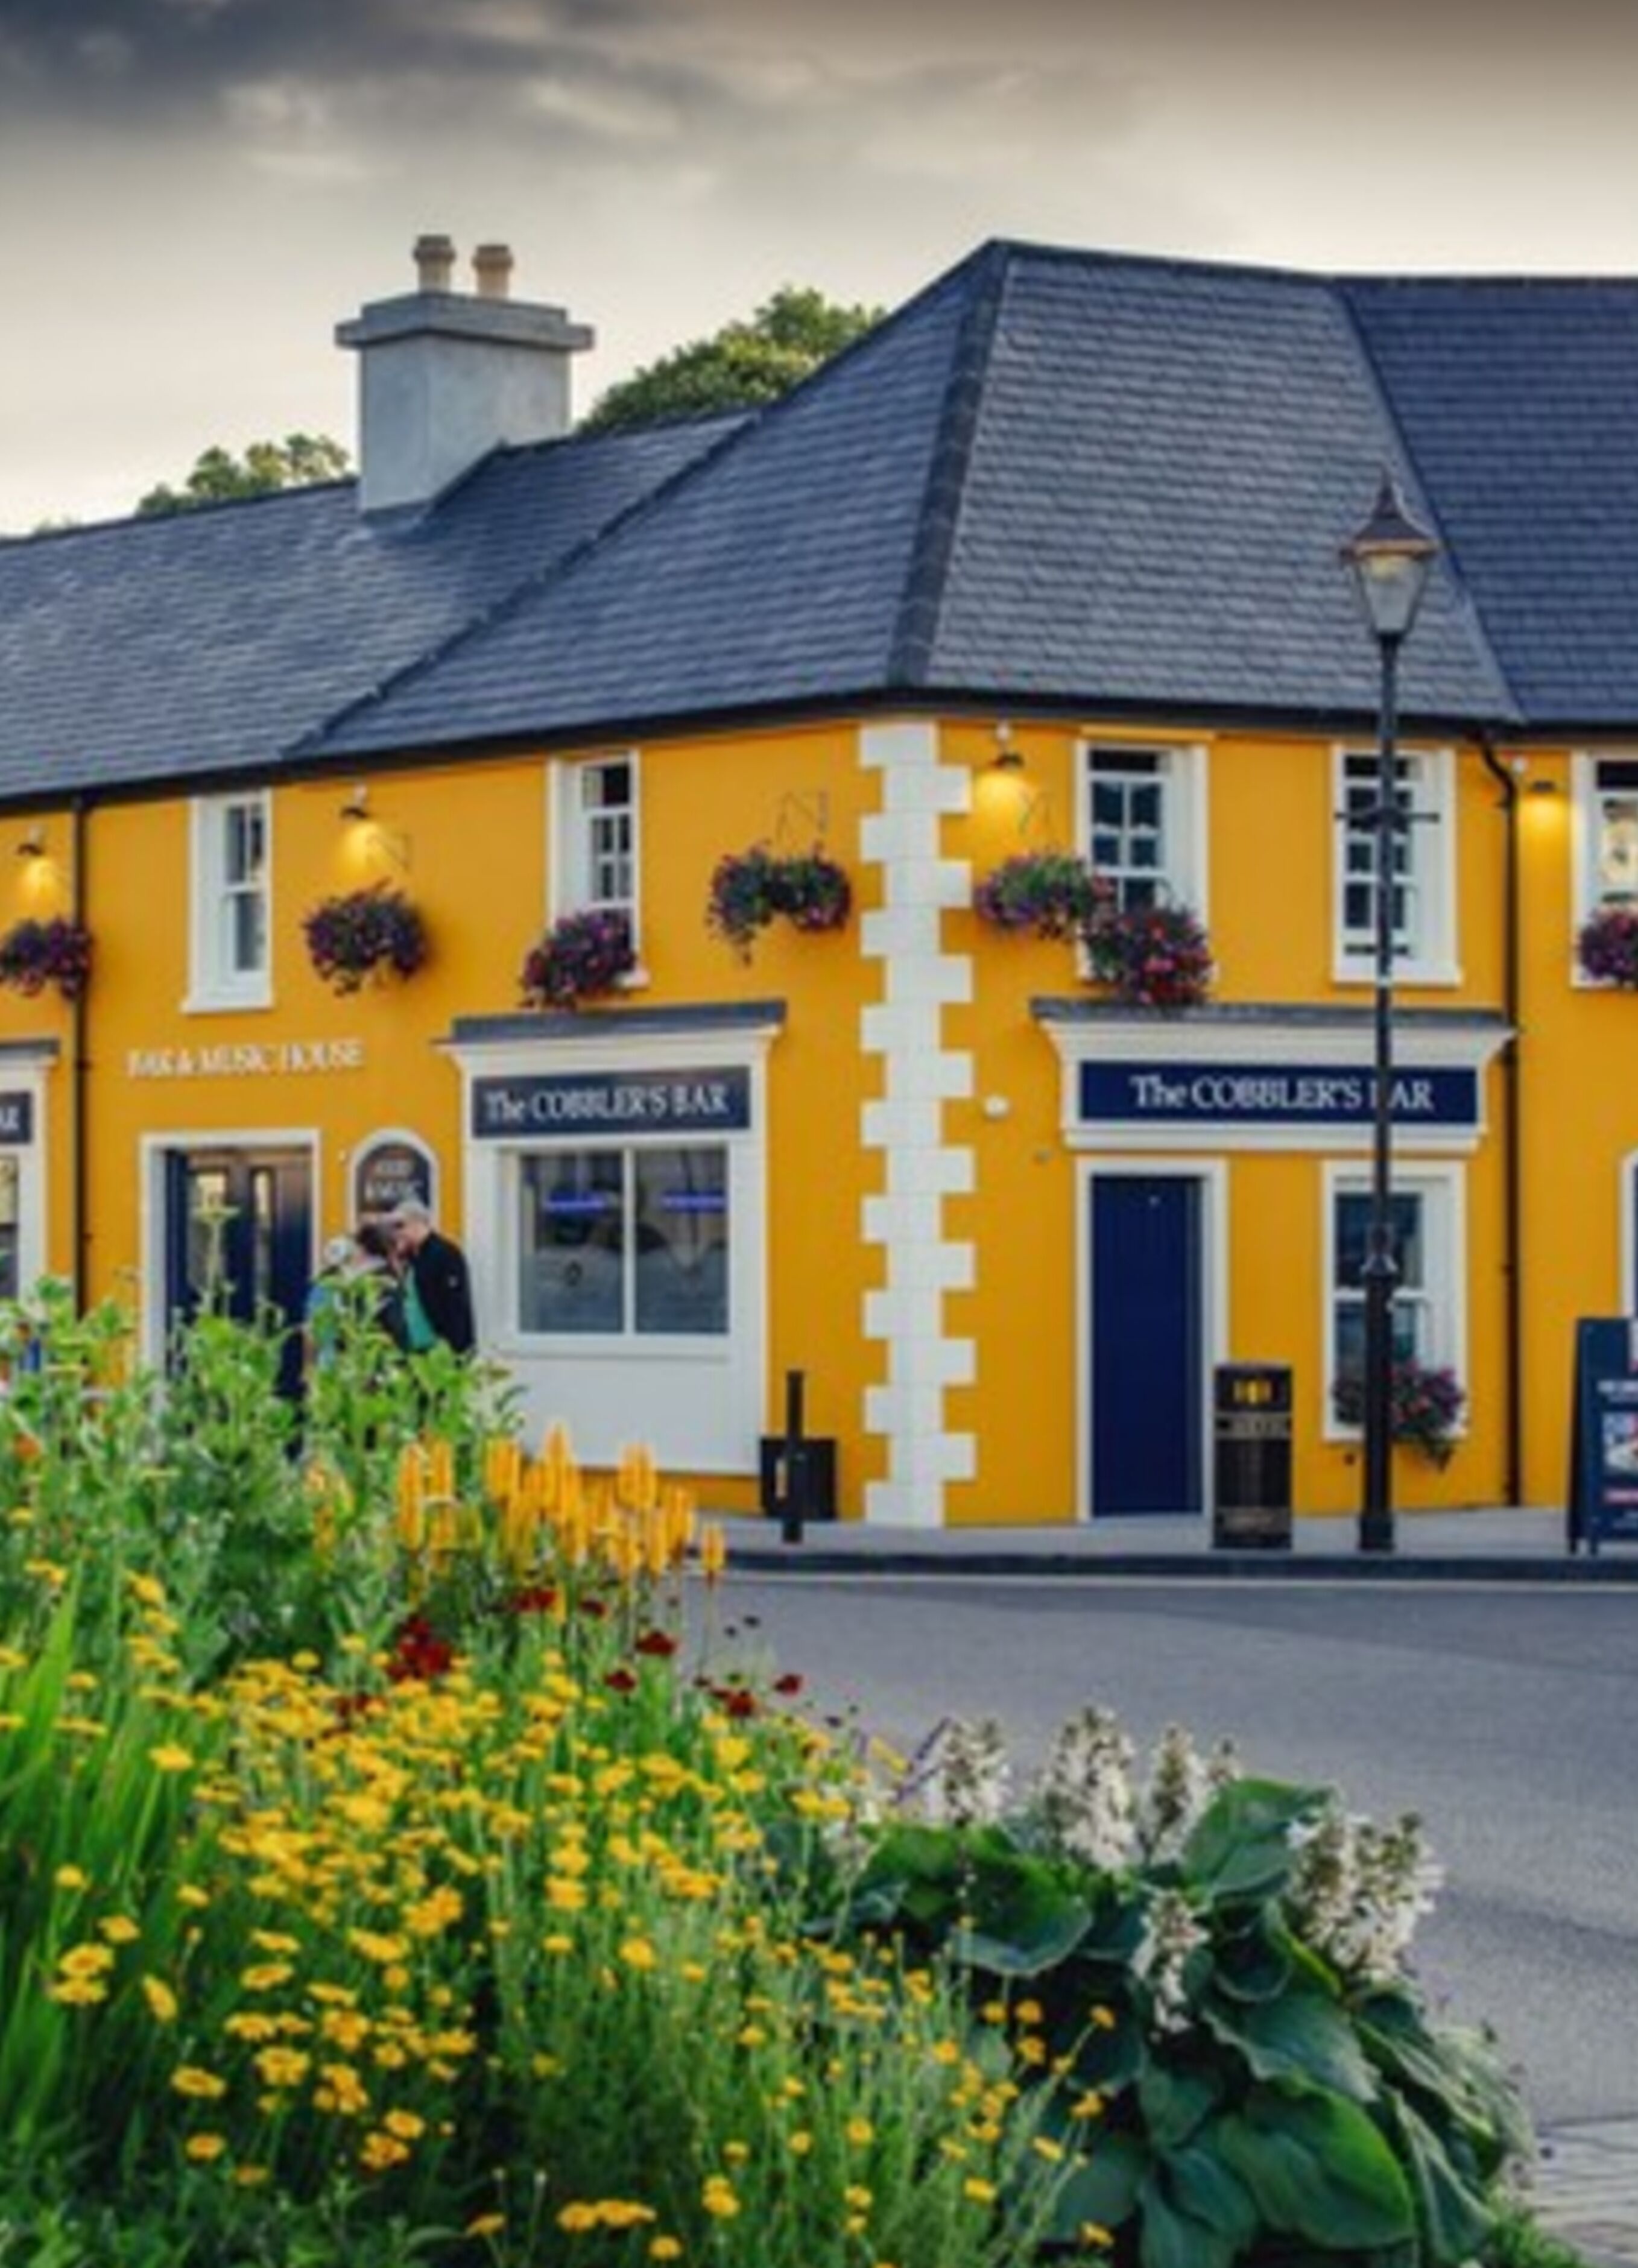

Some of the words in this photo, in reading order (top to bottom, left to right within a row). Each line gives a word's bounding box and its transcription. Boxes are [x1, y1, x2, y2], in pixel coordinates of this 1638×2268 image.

[485, 1089, 525, 1124] The
[673, 1082, 730, 1116] BAR
[1129, 1075, 1187, 1110] The
